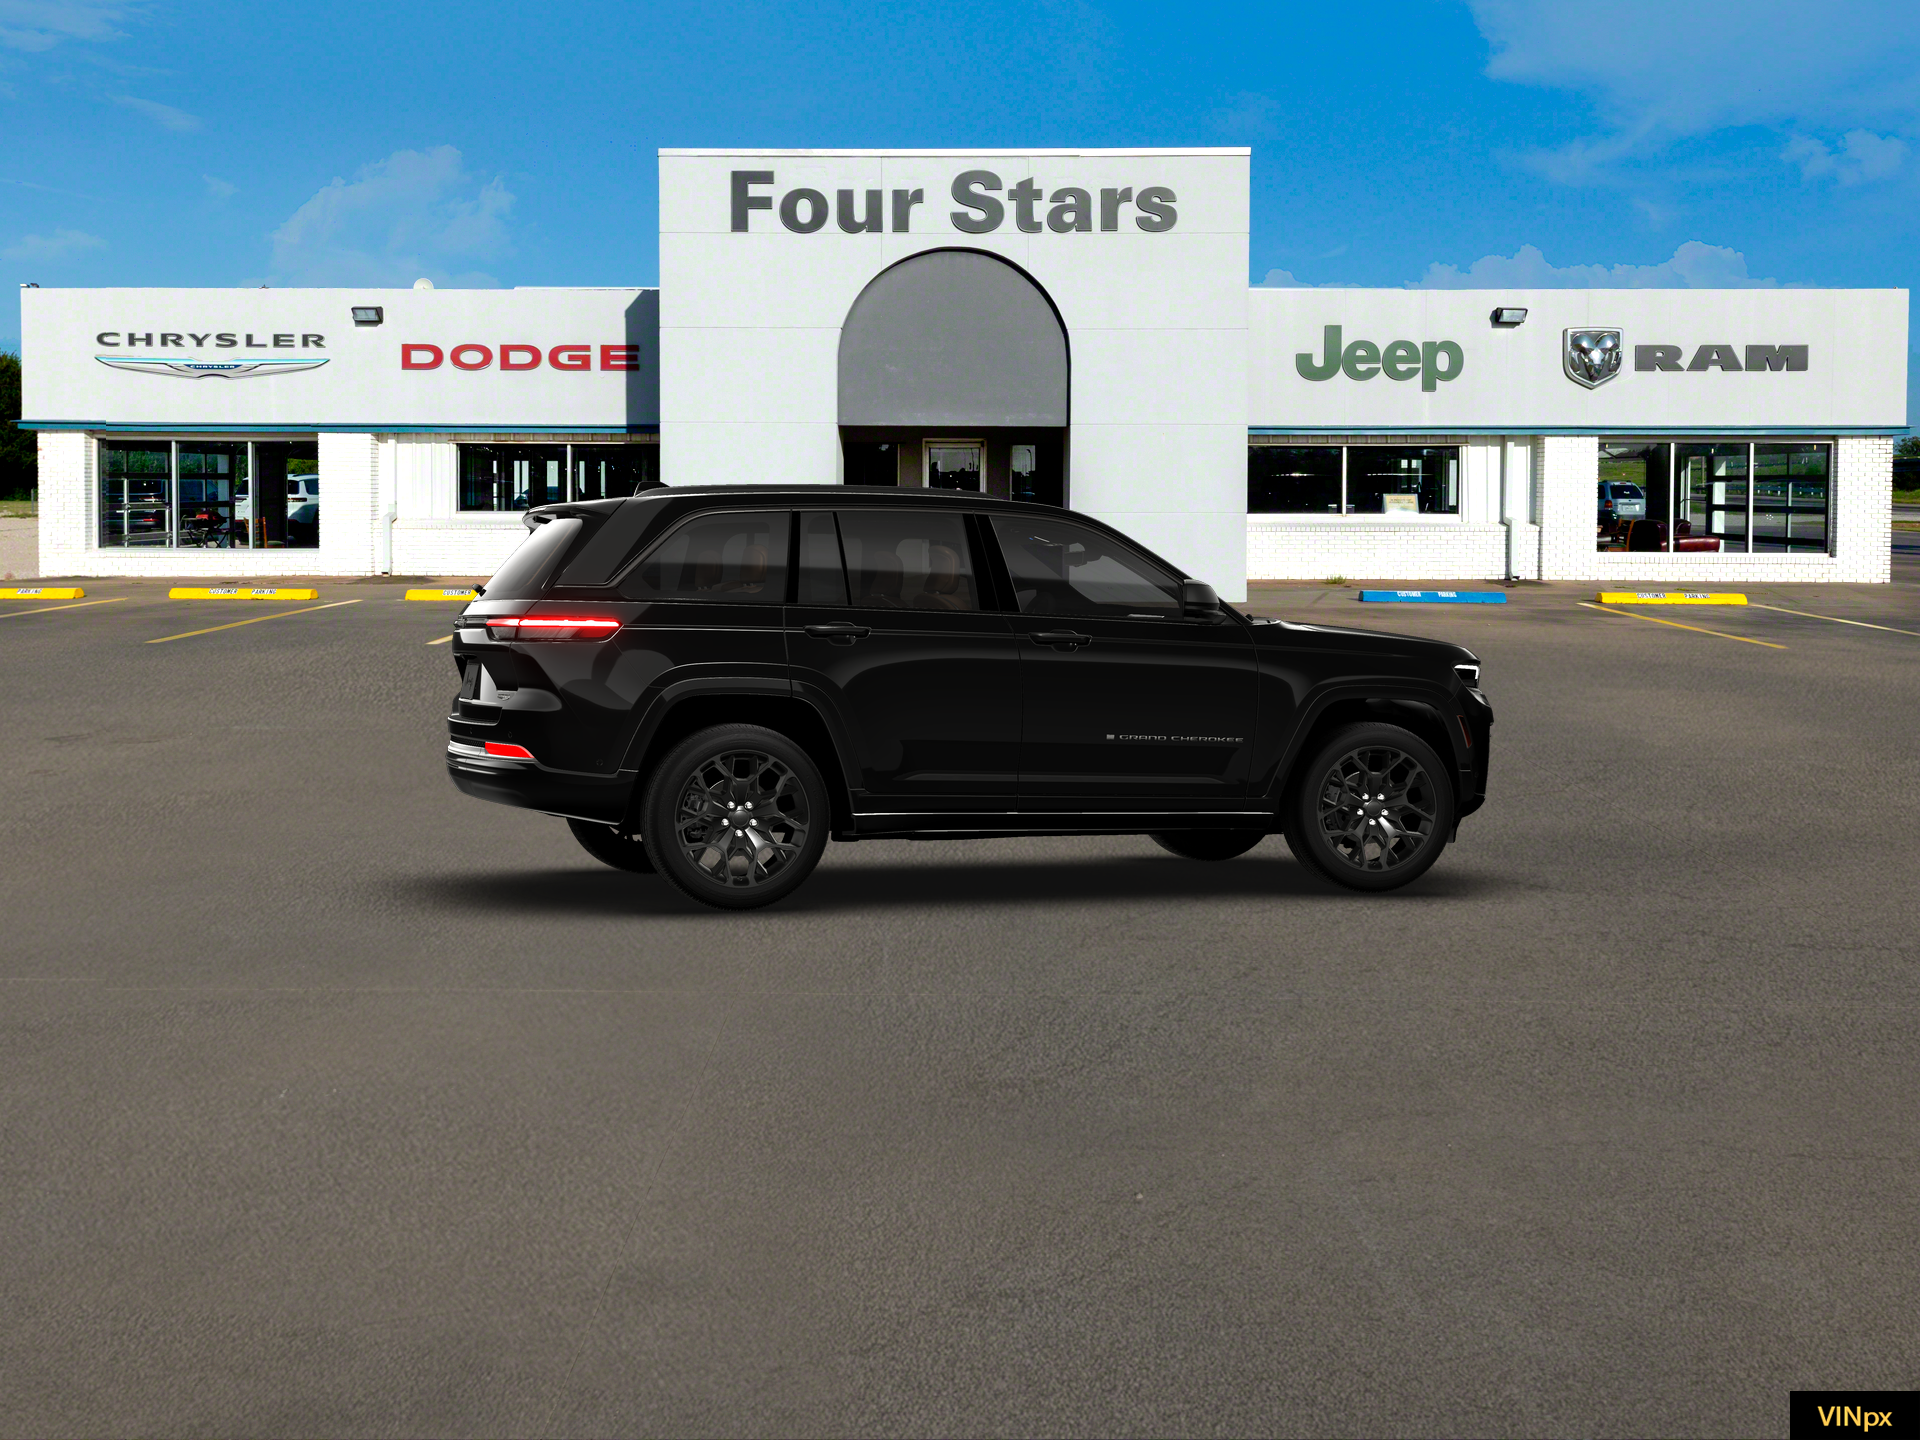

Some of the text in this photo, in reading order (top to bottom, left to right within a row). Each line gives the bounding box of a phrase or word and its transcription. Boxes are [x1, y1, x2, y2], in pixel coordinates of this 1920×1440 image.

[730, 170, 1178, 234] Four Stars
[96, 332, 326, 348] CHRYSLER
[401, 343, 640, 371] DODGE
[1296, 324, 1464, 392] Jeep
[1635, 344, 1808, 372] RAM
[1171, 735, 1244, 743] CHEROKEE
